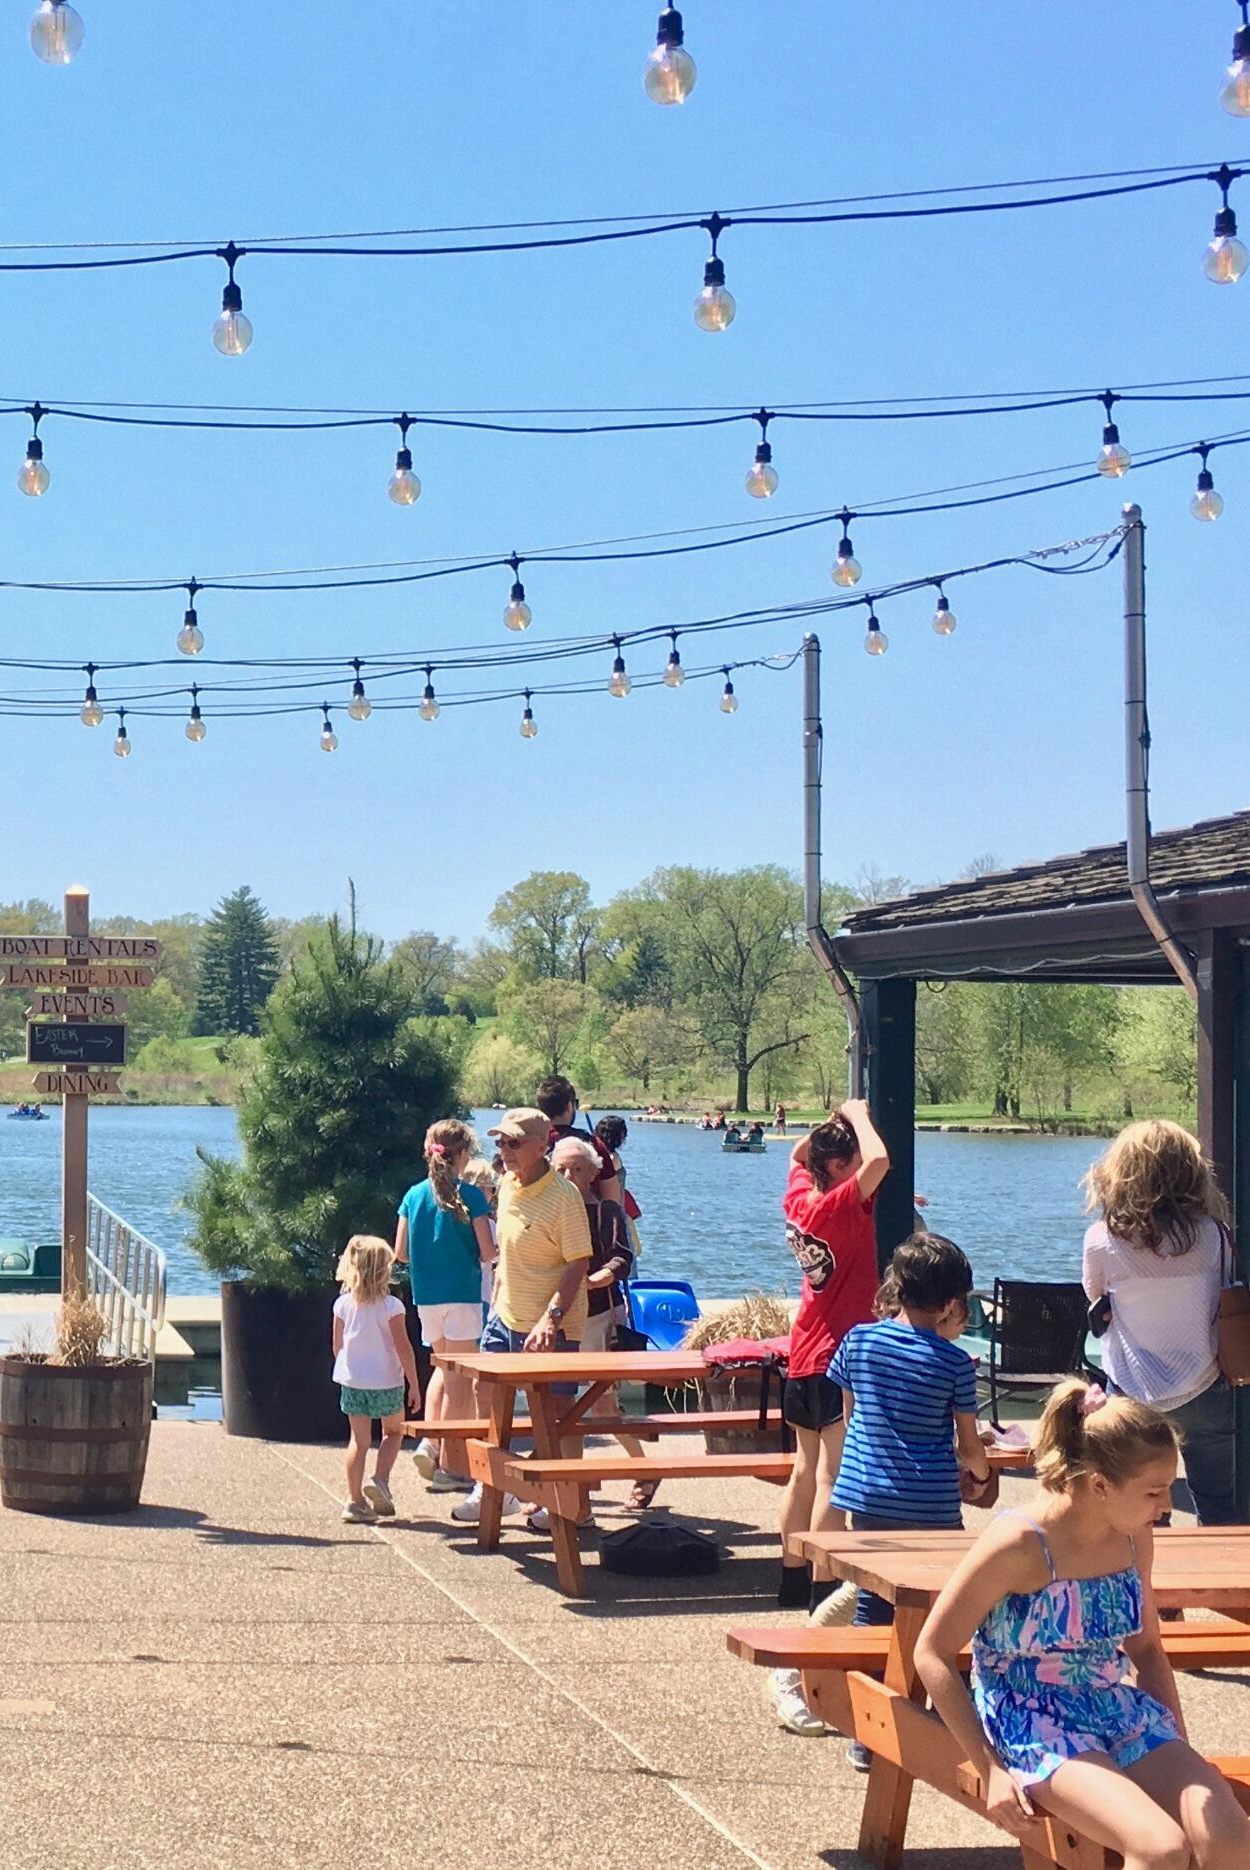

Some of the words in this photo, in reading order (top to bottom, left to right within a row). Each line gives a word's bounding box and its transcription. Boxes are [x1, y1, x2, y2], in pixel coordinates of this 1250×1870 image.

[2, 939, 53, 955] BOAT
[64, 939, 157, 956] RENTALS
[9, 966, 98, 984] LAKESIDE
[107, 968, 146, 986] BAR
[41, 995, 115, 1013] EVENTS
[47, 1074, 108, 1092] DINING
